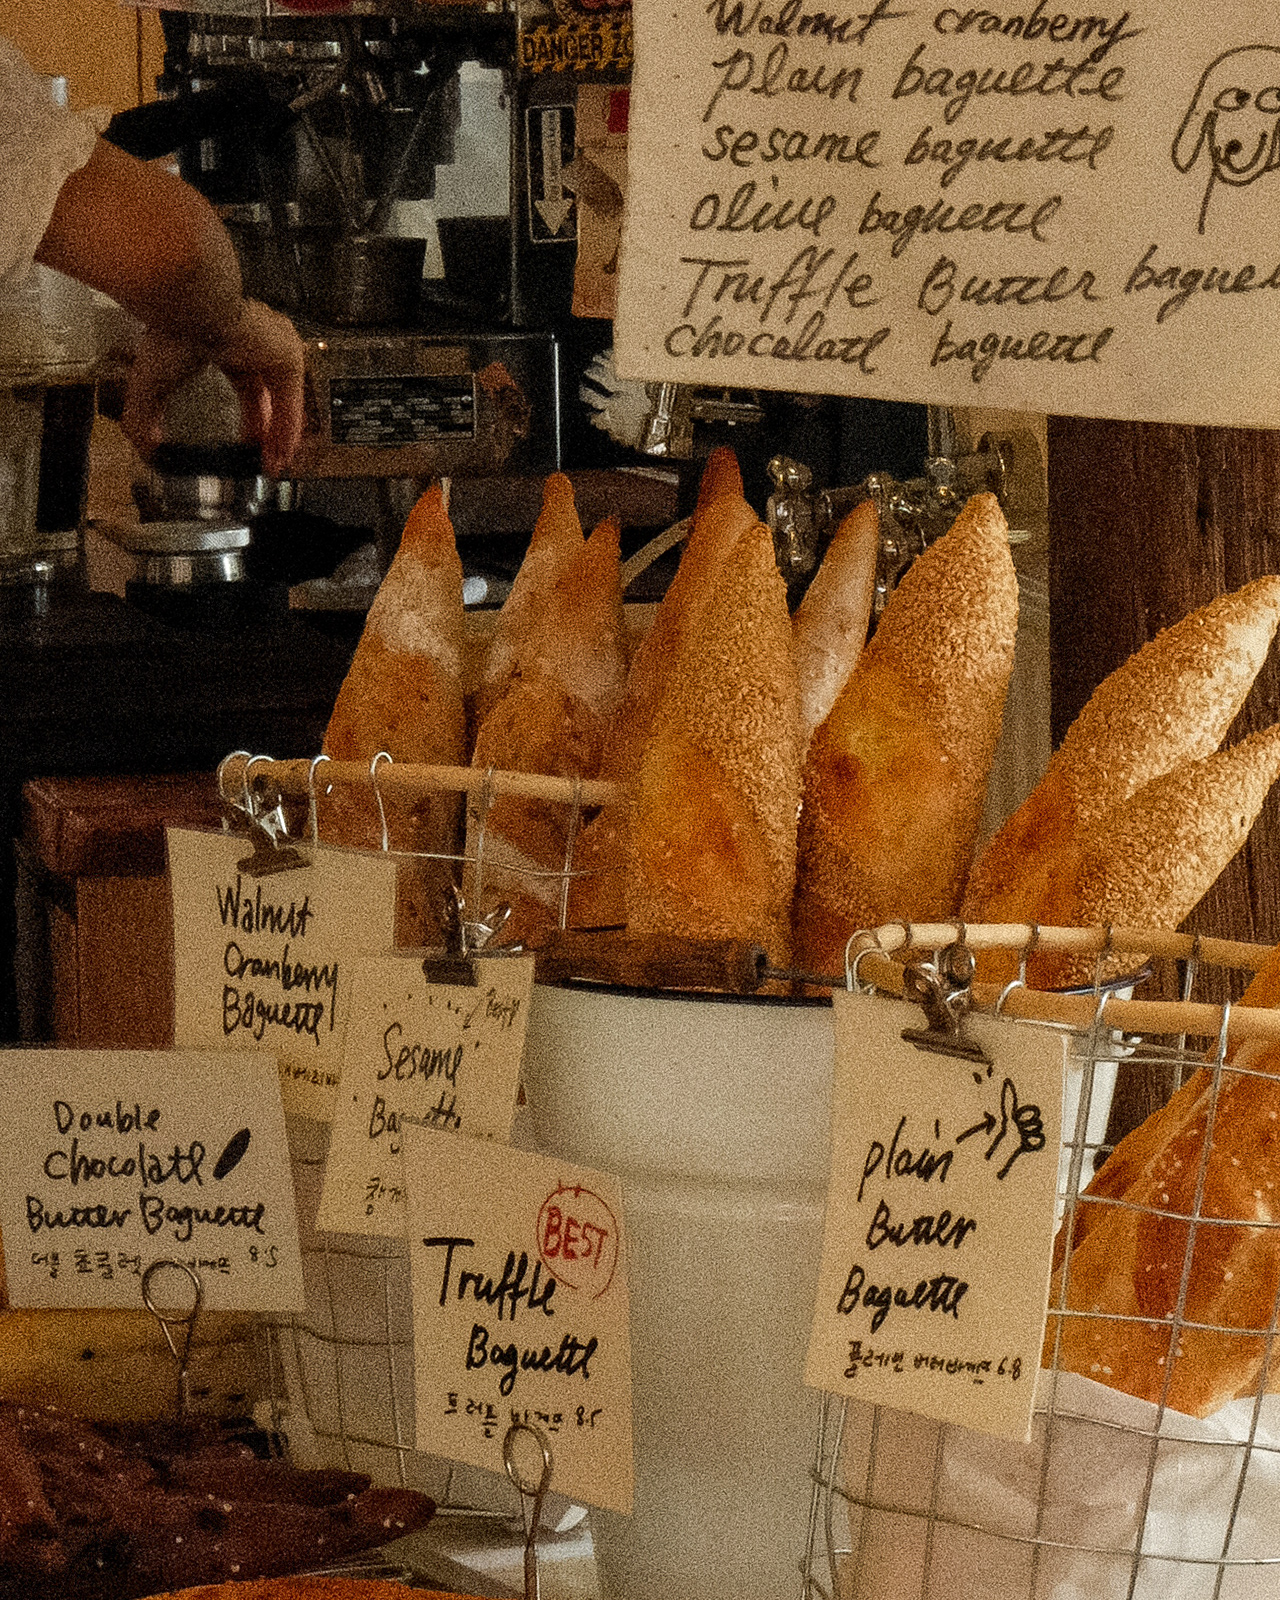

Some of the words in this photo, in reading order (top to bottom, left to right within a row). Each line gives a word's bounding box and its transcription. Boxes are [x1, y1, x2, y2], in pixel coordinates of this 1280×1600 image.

[523, 32, 603, 62] DANGER
[891, 51, 1128, 120] baguette
[905, 123, 1115, 185] baguette
[858, 188, 1065, 257] baguette
[680, 246, 882, 323] Truffle
[930, 323, 1115, 381] baguette
[216, 874, 314, 937] Walnut
[53, 1100, 161, 1135] Double
[543, 1205, 608, 1269] BEST
[423, 1237, 557, 1321] Truffle
